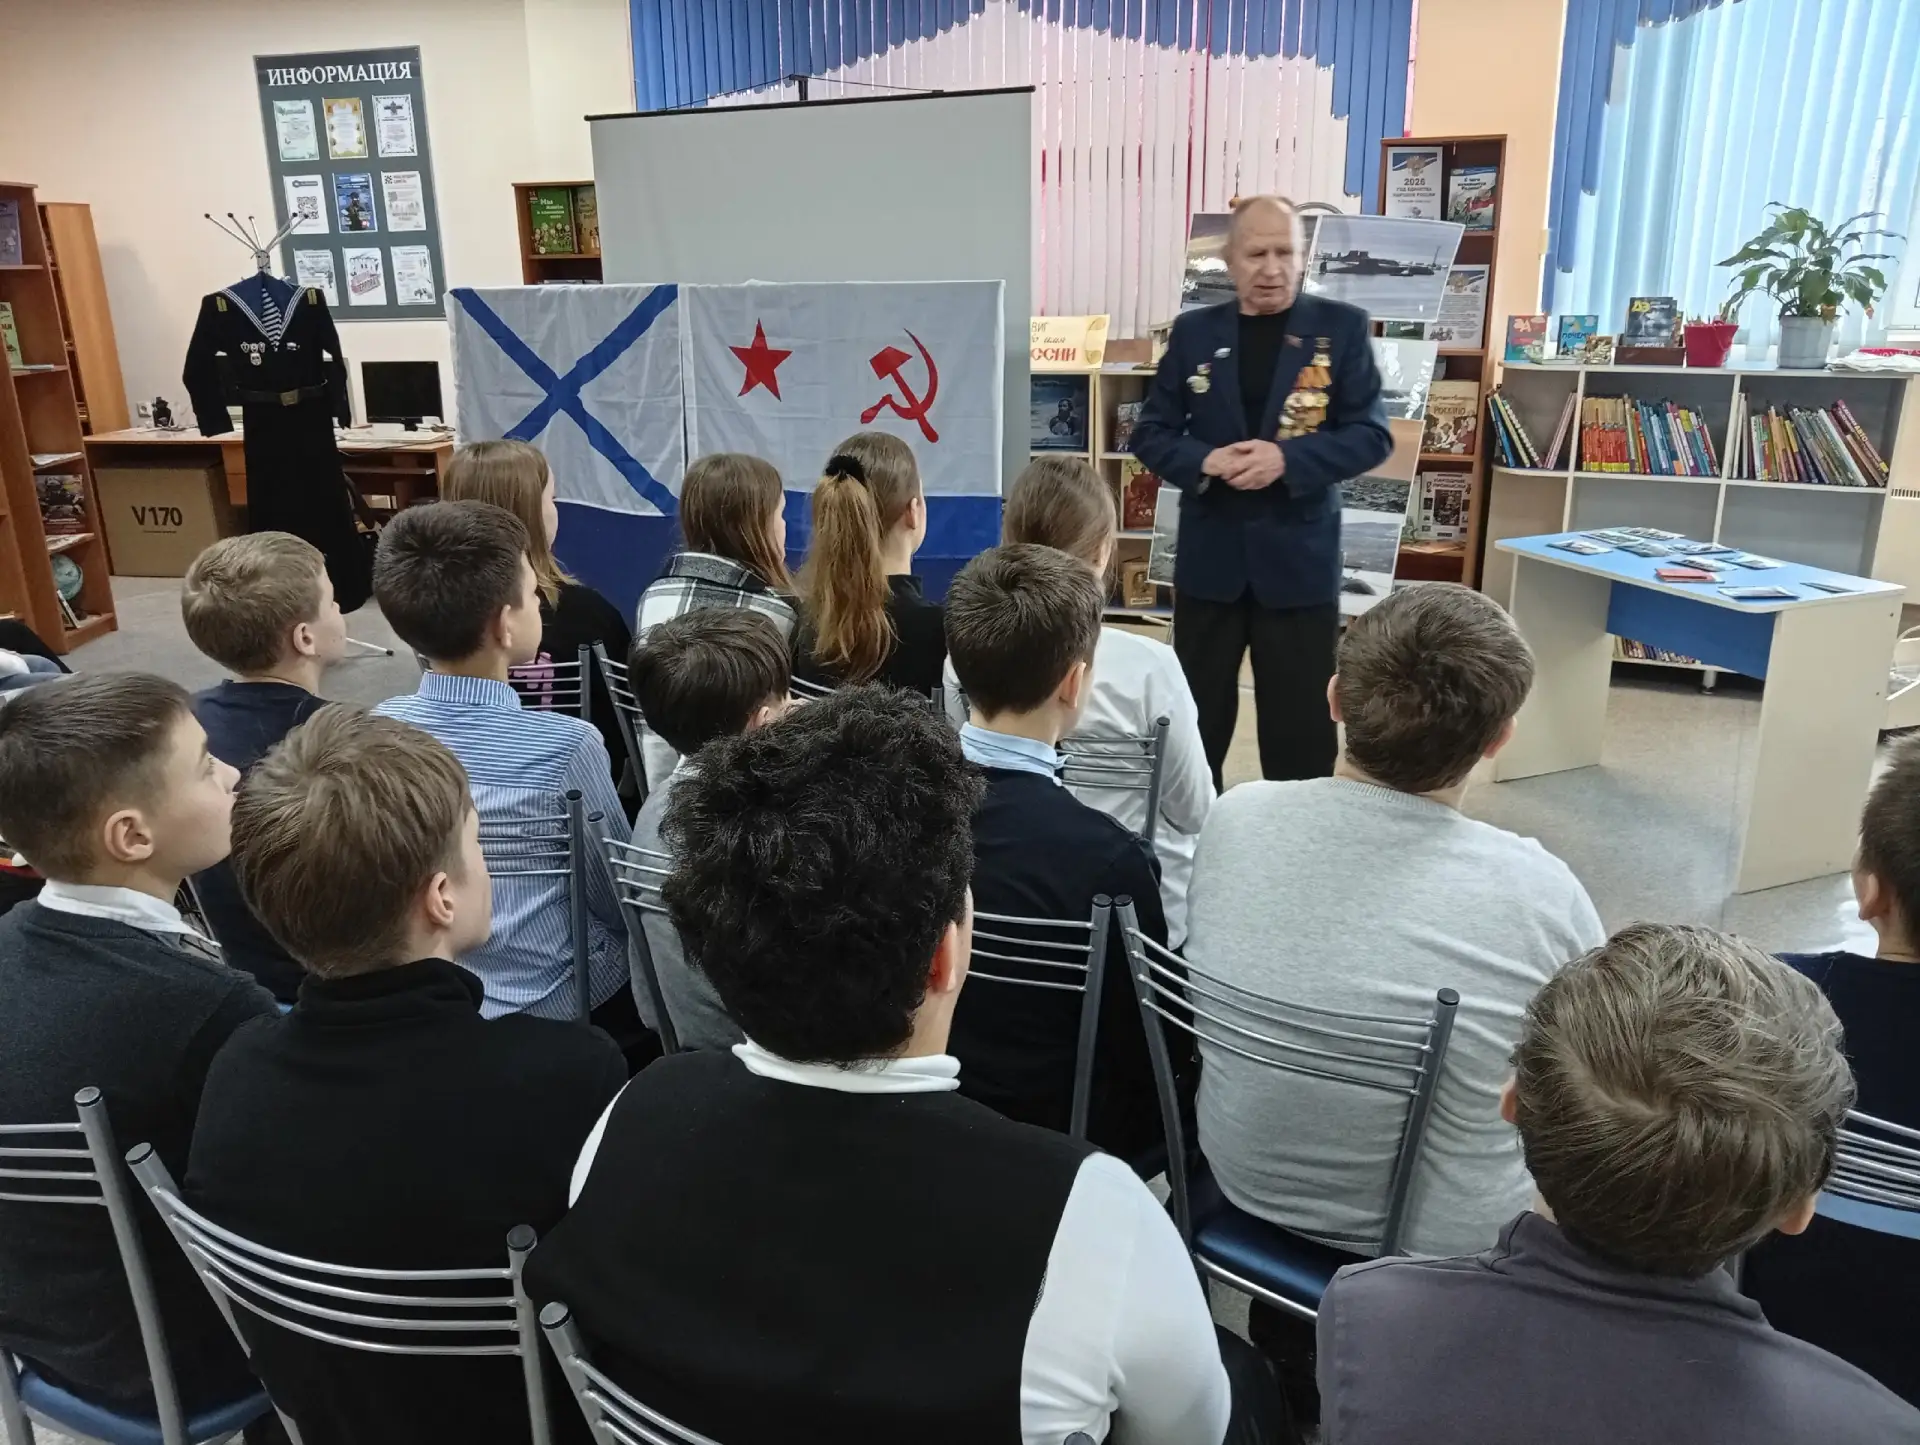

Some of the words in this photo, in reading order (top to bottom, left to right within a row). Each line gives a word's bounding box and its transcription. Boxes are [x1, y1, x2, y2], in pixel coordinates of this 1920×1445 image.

[267, 61, 412, 86] ИНФОРМАЦИЯ
[1403, 178, 1426, 186] 2026
[131, 506, 183, 526] V170
